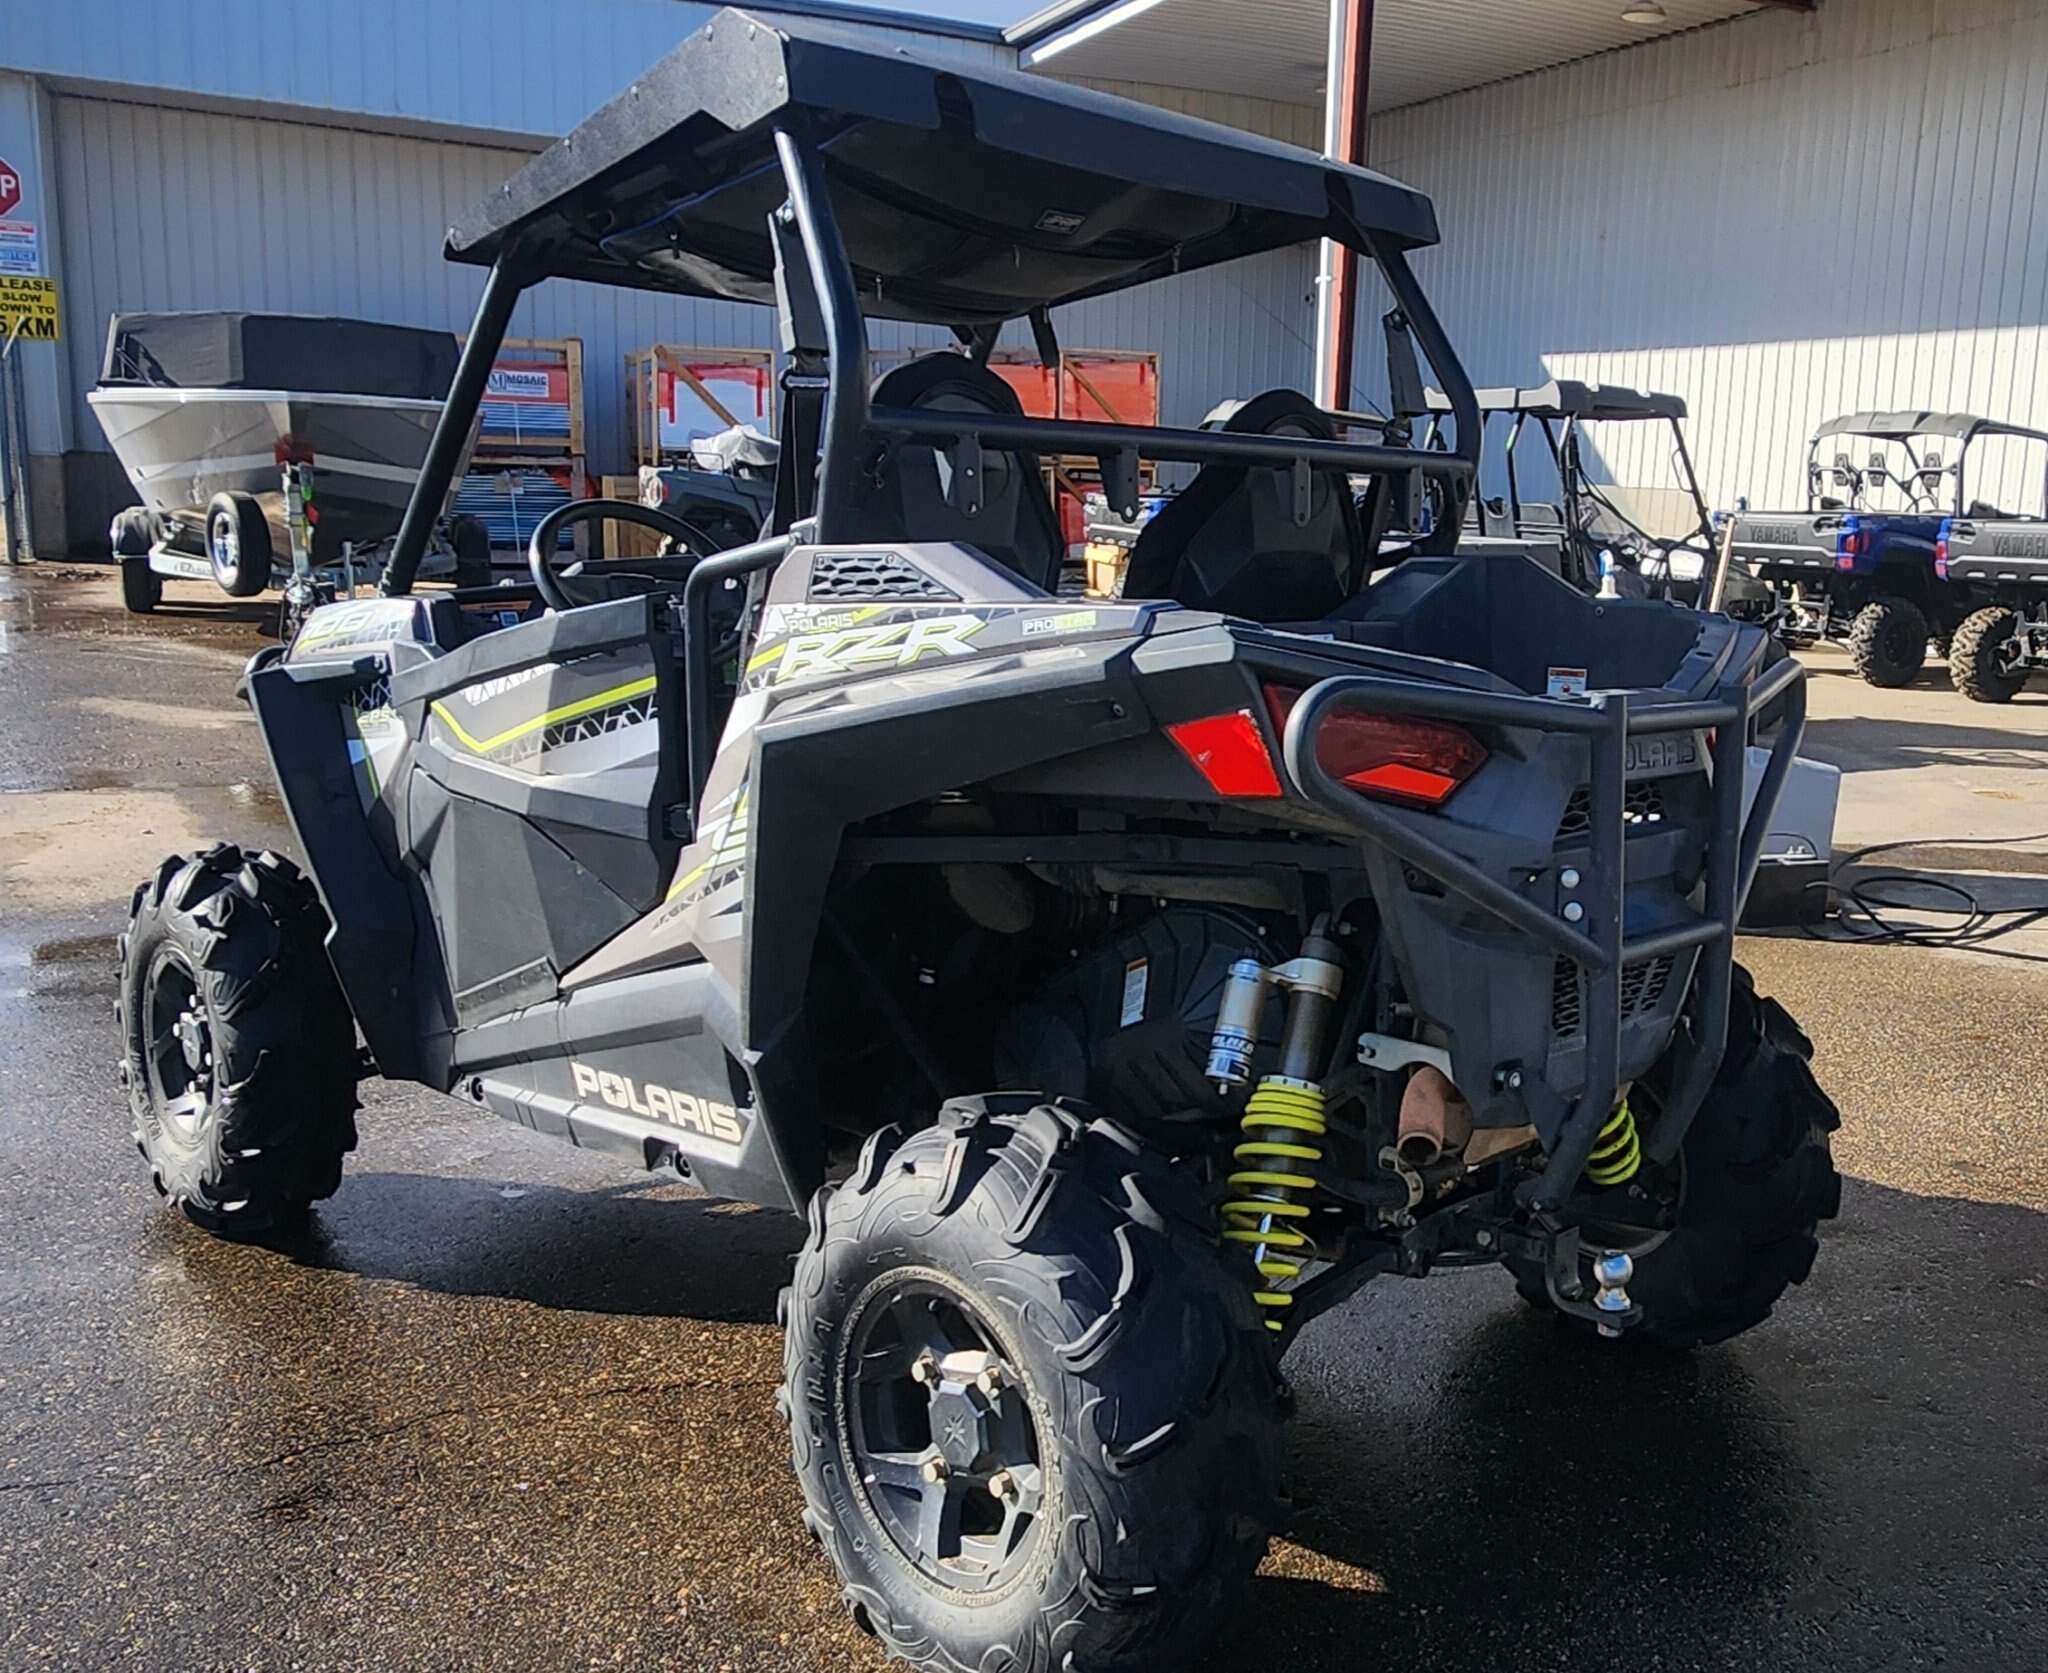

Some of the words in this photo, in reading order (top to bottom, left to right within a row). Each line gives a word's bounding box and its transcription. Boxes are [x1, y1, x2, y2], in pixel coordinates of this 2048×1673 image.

[0, 278, 55, 292] LEASE
[2, 292, 41, 302] SLOW
[0, 303, 32, 313] OWN
[36, 305, 55, 314] TO
[16, 316, 55, 338] KM
[506, 374, 547, 386] MOSAIC
[1750, 524, 1800, 545] YAMAHA
[1991, 533, 2048, 558] YAMAH
[788, 613, 854, 635] POLARIS
[775, 614, 988, 684] RZR
[1625, 735, 1697, 772] OLARIS
[570, 1061, 743, 1144] POLARIS
